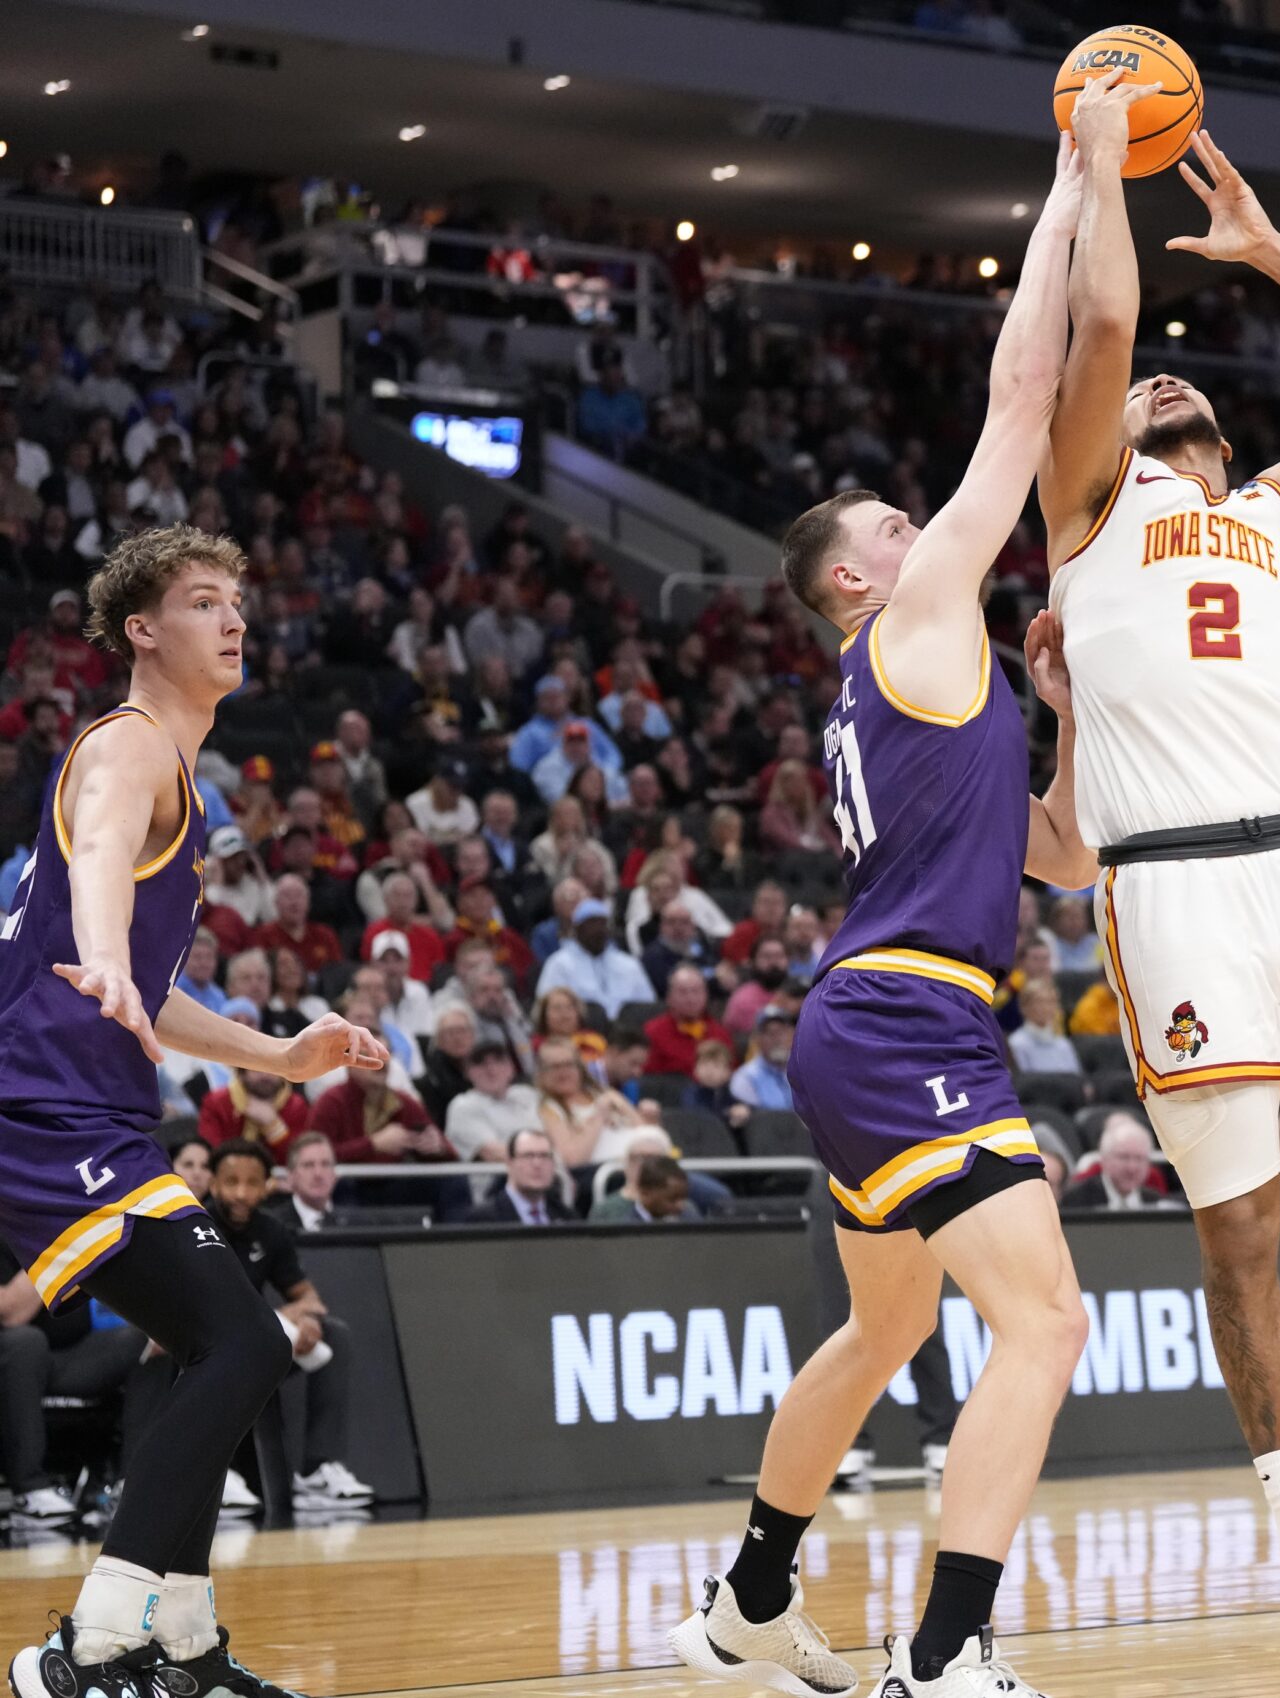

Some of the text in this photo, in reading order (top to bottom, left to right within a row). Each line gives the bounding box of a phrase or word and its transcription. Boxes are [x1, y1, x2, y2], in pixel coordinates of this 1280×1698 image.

[1071, 49, 1141, 73] NCAA
[1141, 511, 1278, 579] IOWA STATE
[1187, 581, 1242, 660] 2
[924, 1074, 971, 1117] L
[74, 1156, 117, 1197] L
